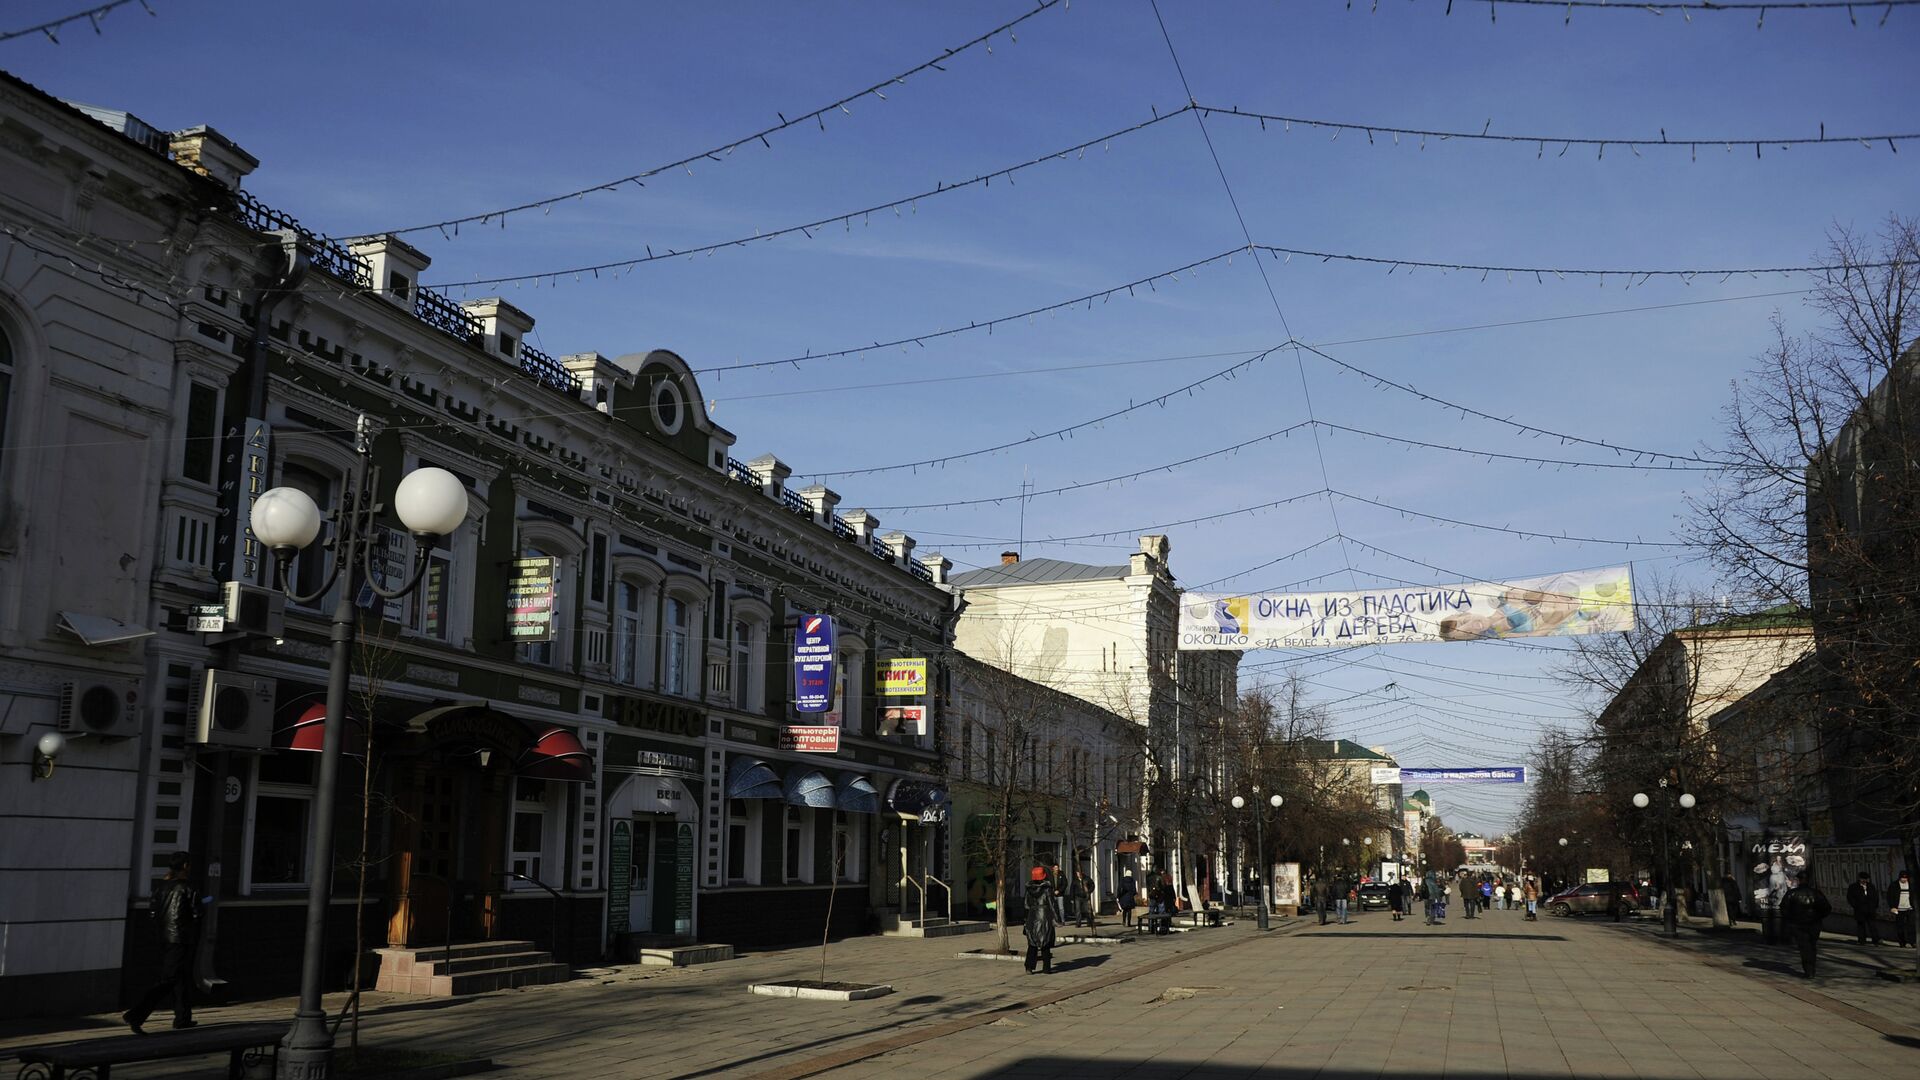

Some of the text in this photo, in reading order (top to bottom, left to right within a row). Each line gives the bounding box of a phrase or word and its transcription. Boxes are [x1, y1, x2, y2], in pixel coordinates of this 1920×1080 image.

[1258, 589, 1472, 618] ОКНА ИЗ ПЛАСТИКА
[1312, 615, 1417, 639] И ДЕРЕВА
[1183, 633, 1249, 645] ОКОШКО
[1284, 639, 1317, 647] ВЕЛЕС
[1323, 639, 1331, 648] 3
[797, 645, 830, 654] ОПЕРАТИВНОЙ
[794, 654, 832, 663] БУХГАЛТЕРСКОЙ
[877, 670, 916, 681] КНИГИ
[622, 696, 702, 737] ВЕЛЕС
[1752, 843, 1806, 854] МЕХА
